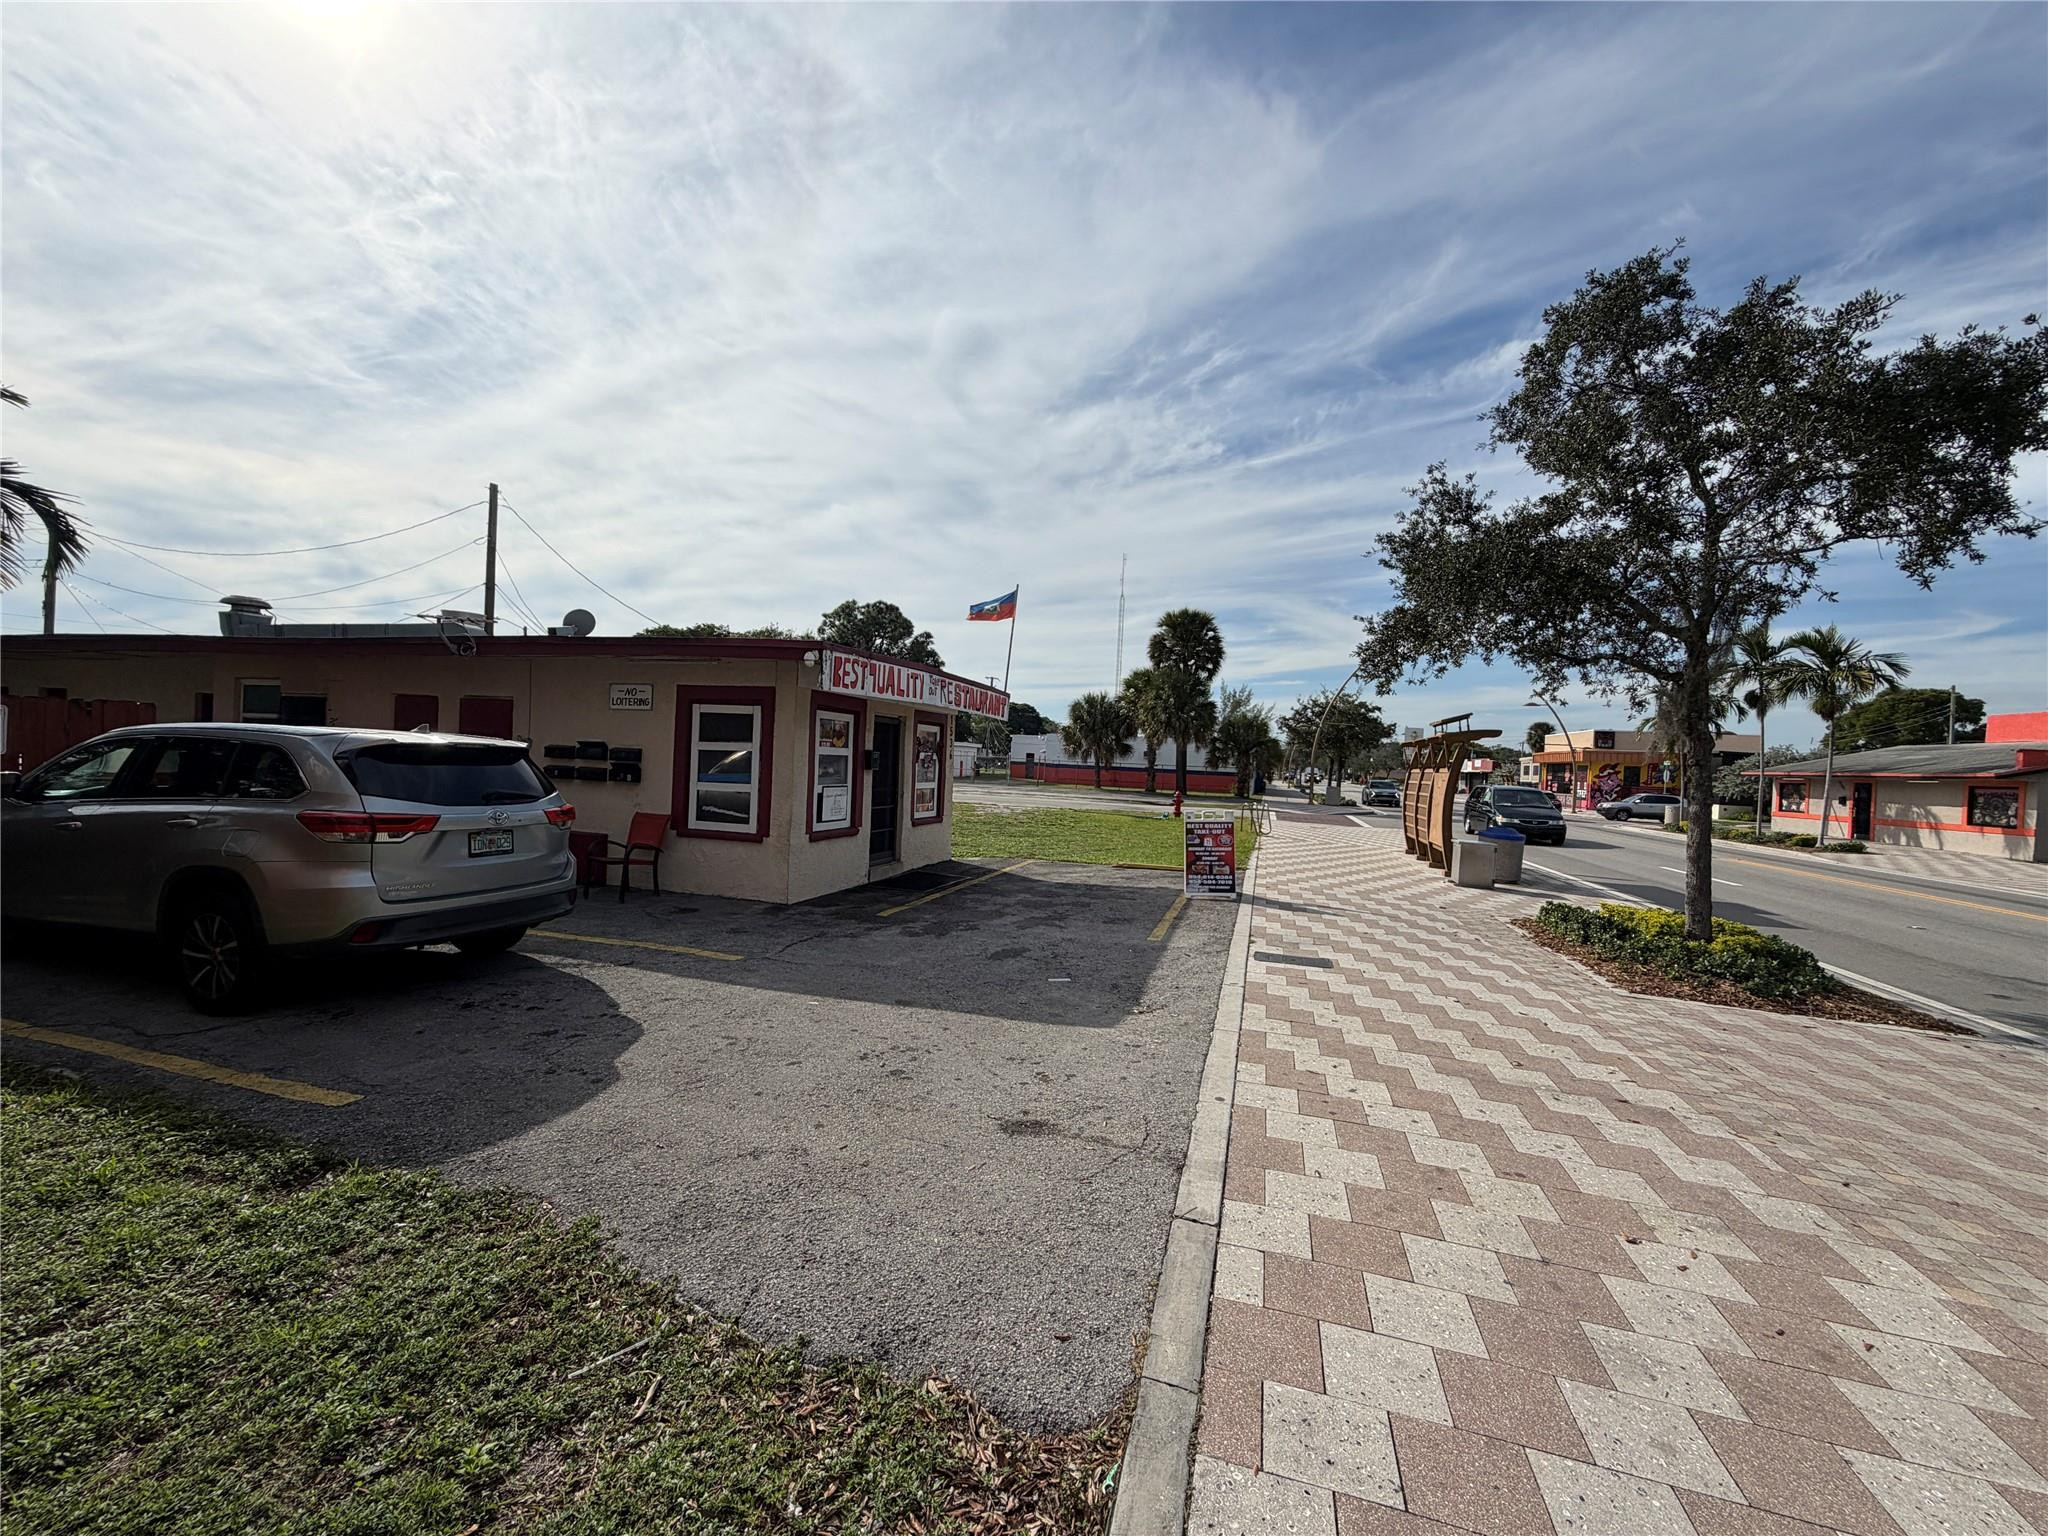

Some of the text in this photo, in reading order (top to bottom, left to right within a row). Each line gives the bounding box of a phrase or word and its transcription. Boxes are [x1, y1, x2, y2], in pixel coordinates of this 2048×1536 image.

[832, 656, 868, 690] BEST
[611, 697, 650, 707] LOITERING
[624, 687, 638, 697] NO
[940, 680, 1007, 718] RESTAURANT
